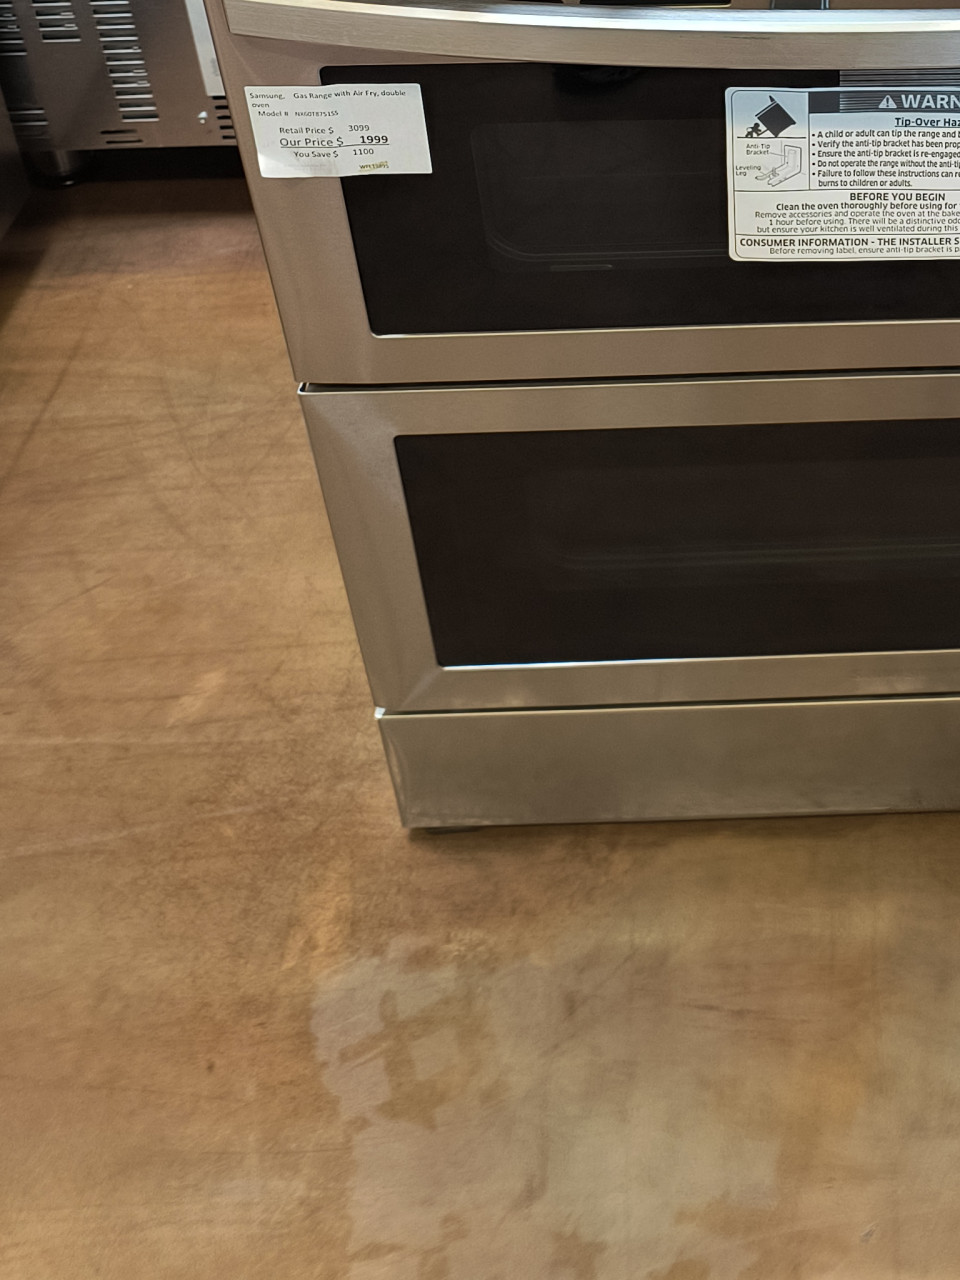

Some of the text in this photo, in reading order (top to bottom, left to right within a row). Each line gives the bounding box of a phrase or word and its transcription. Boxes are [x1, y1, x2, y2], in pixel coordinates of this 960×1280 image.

[309, 92, 332, 101] Range
[365, 90, 379, 98] Fry,
[895, 117, 941, 127] Tip-Over
[305, 127, 326, 135] Price
[328, 127, 334, 135] $
[825, 130, 844, 138] child
[856, 130, 876, 138] adult
[892, 130, 902, 138] tip
[918, 131, 941, 139] range
[941, 130, 956, 138] and
[280, 136, 389, 147] Our Price $ 1999
[817, 140, 840, 149] Verify
[856, 140, 881, 149] anti-tip
[926, 140, 943, 148] been
[333, 150, 339, 158] $
[353, 148, 374, 156] 1100
[817, 150, 843, 158] Ensure
[857, 150, 883, 158] anti-tip
[885, 150, 912, 158] bracket
[842, 160, 867, 169] operate
[880, 161, 899, 169] range
[900, 160, 926, 168] without
[927, 160, 938, 168] the
[853, 169, 876, 177] follow
[898, 170, 939, 178] instructions
[818, 179, 838, 187] burns
[850, 179, 878, 187] children
[889, 179, 912, 187] adults.
[850, 193, 946, 201] BEFORE YOU BEGIN
[776, 203, 799, 211] Clean
[840, 202, 888, 211] thoroughly
[891, 202, 918, 210] before
[920, 202, 943, 211] using
[945, 202, 958, 210] for
[755, 211, 786, 219] Remove
[834, 210, 848, 218] and
[850, 211, 881, 219] operate
[740, 238, 796, 247] CONSUMER
[798, 238, 869, 247] INFORMATION
[877, 238, 897, 246] THE
[899, 237, 952, 246] INSTALLER
[770, 247, 796, 255] Before
[797, 247, 834, 256] removing
